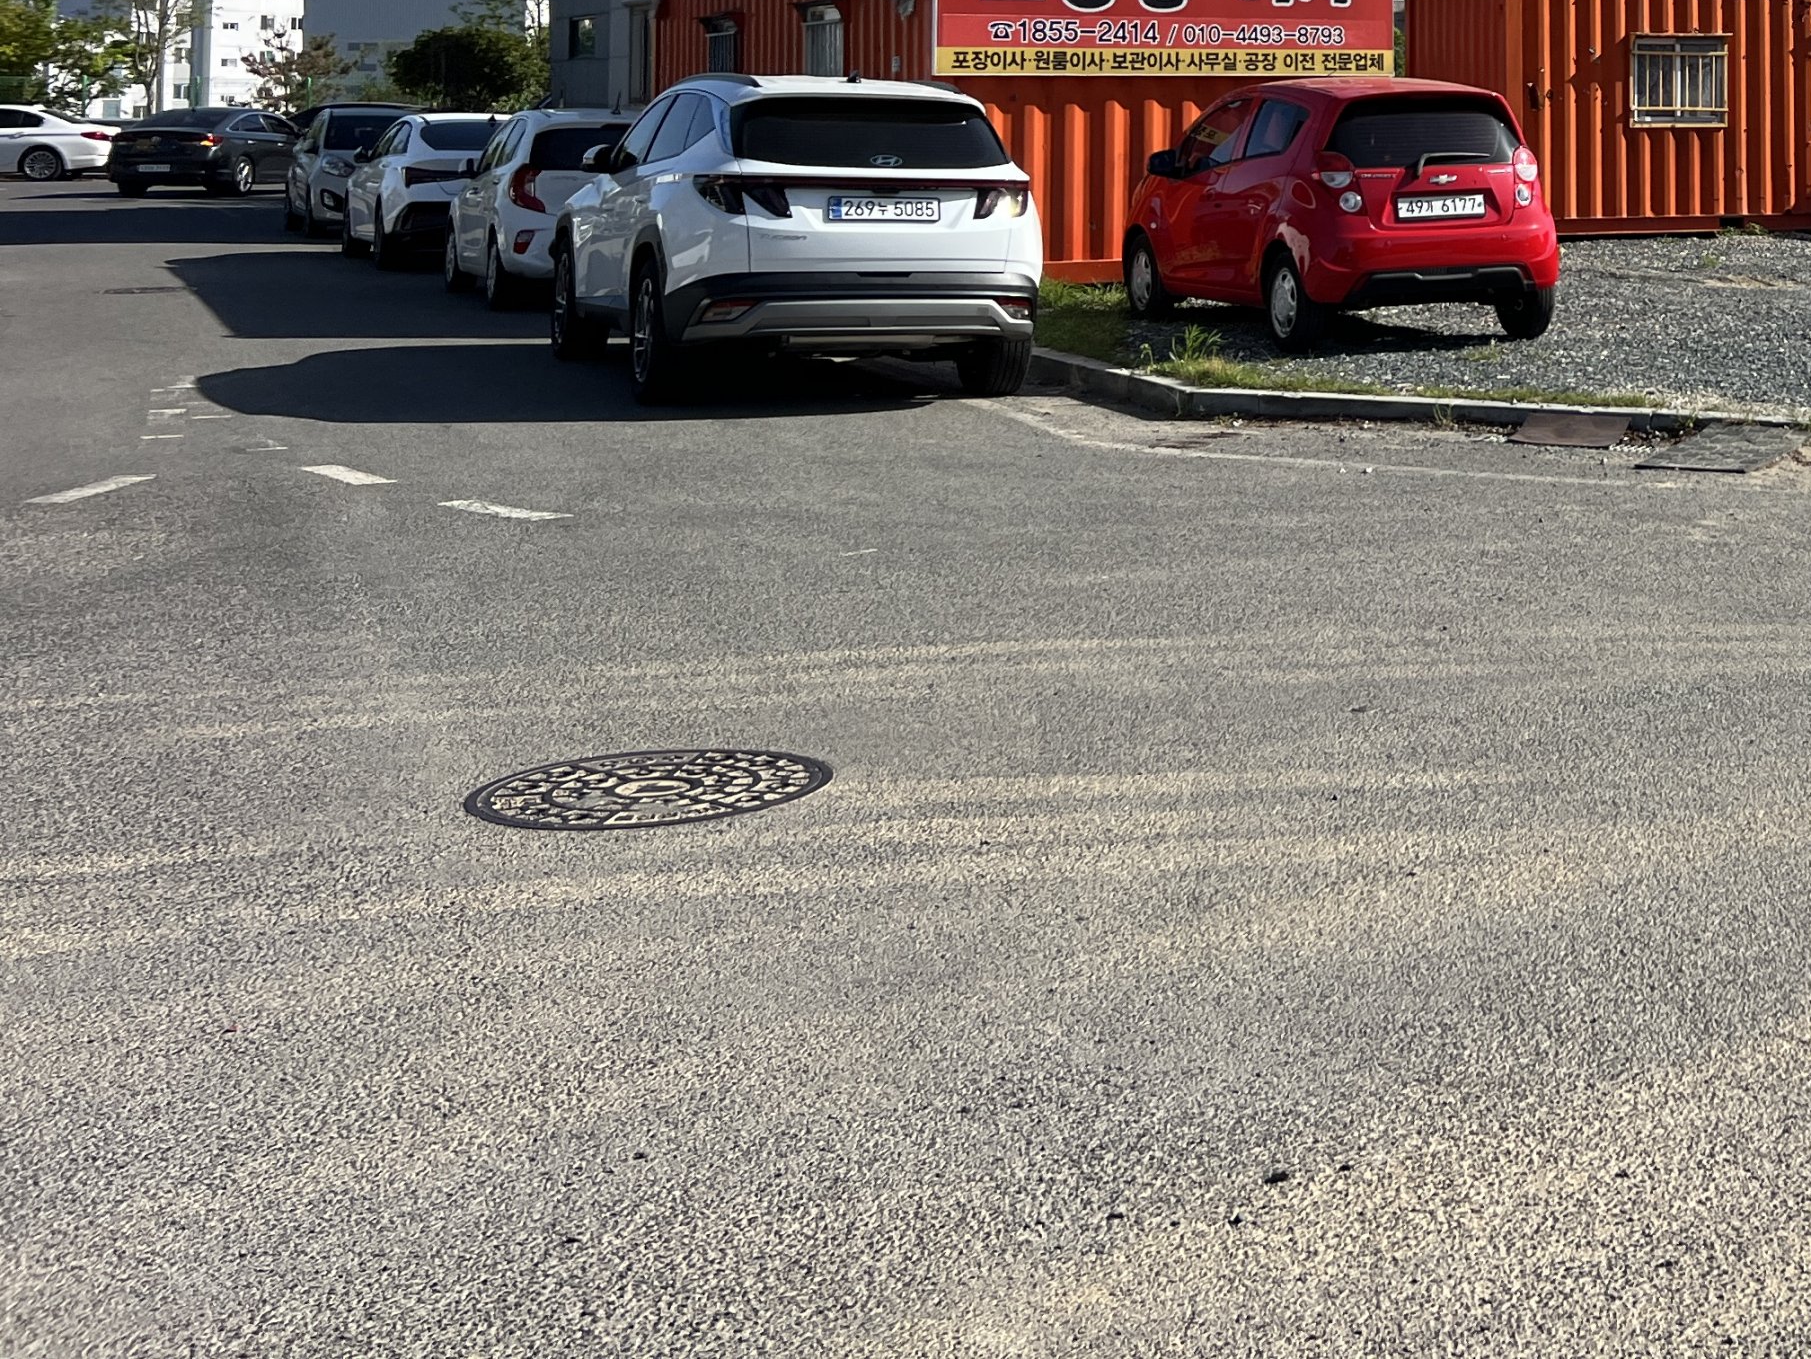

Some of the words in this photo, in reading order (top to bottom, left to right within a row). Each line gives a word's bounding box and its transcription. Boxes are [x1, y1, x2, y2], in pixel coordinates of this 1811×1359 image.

[1017, 18, 1159, 44] 1855-2414
[1183, 24, 1344, 45] 010-4493-8793
[1283, 52, 1316, 71] 이전
[1321, 52, 1385, 72] 전문업체
[844, 200, 889, 217] 269누
[893, 200, 935, 217] 5085
[1441, 197, 1476, 213] 6177
